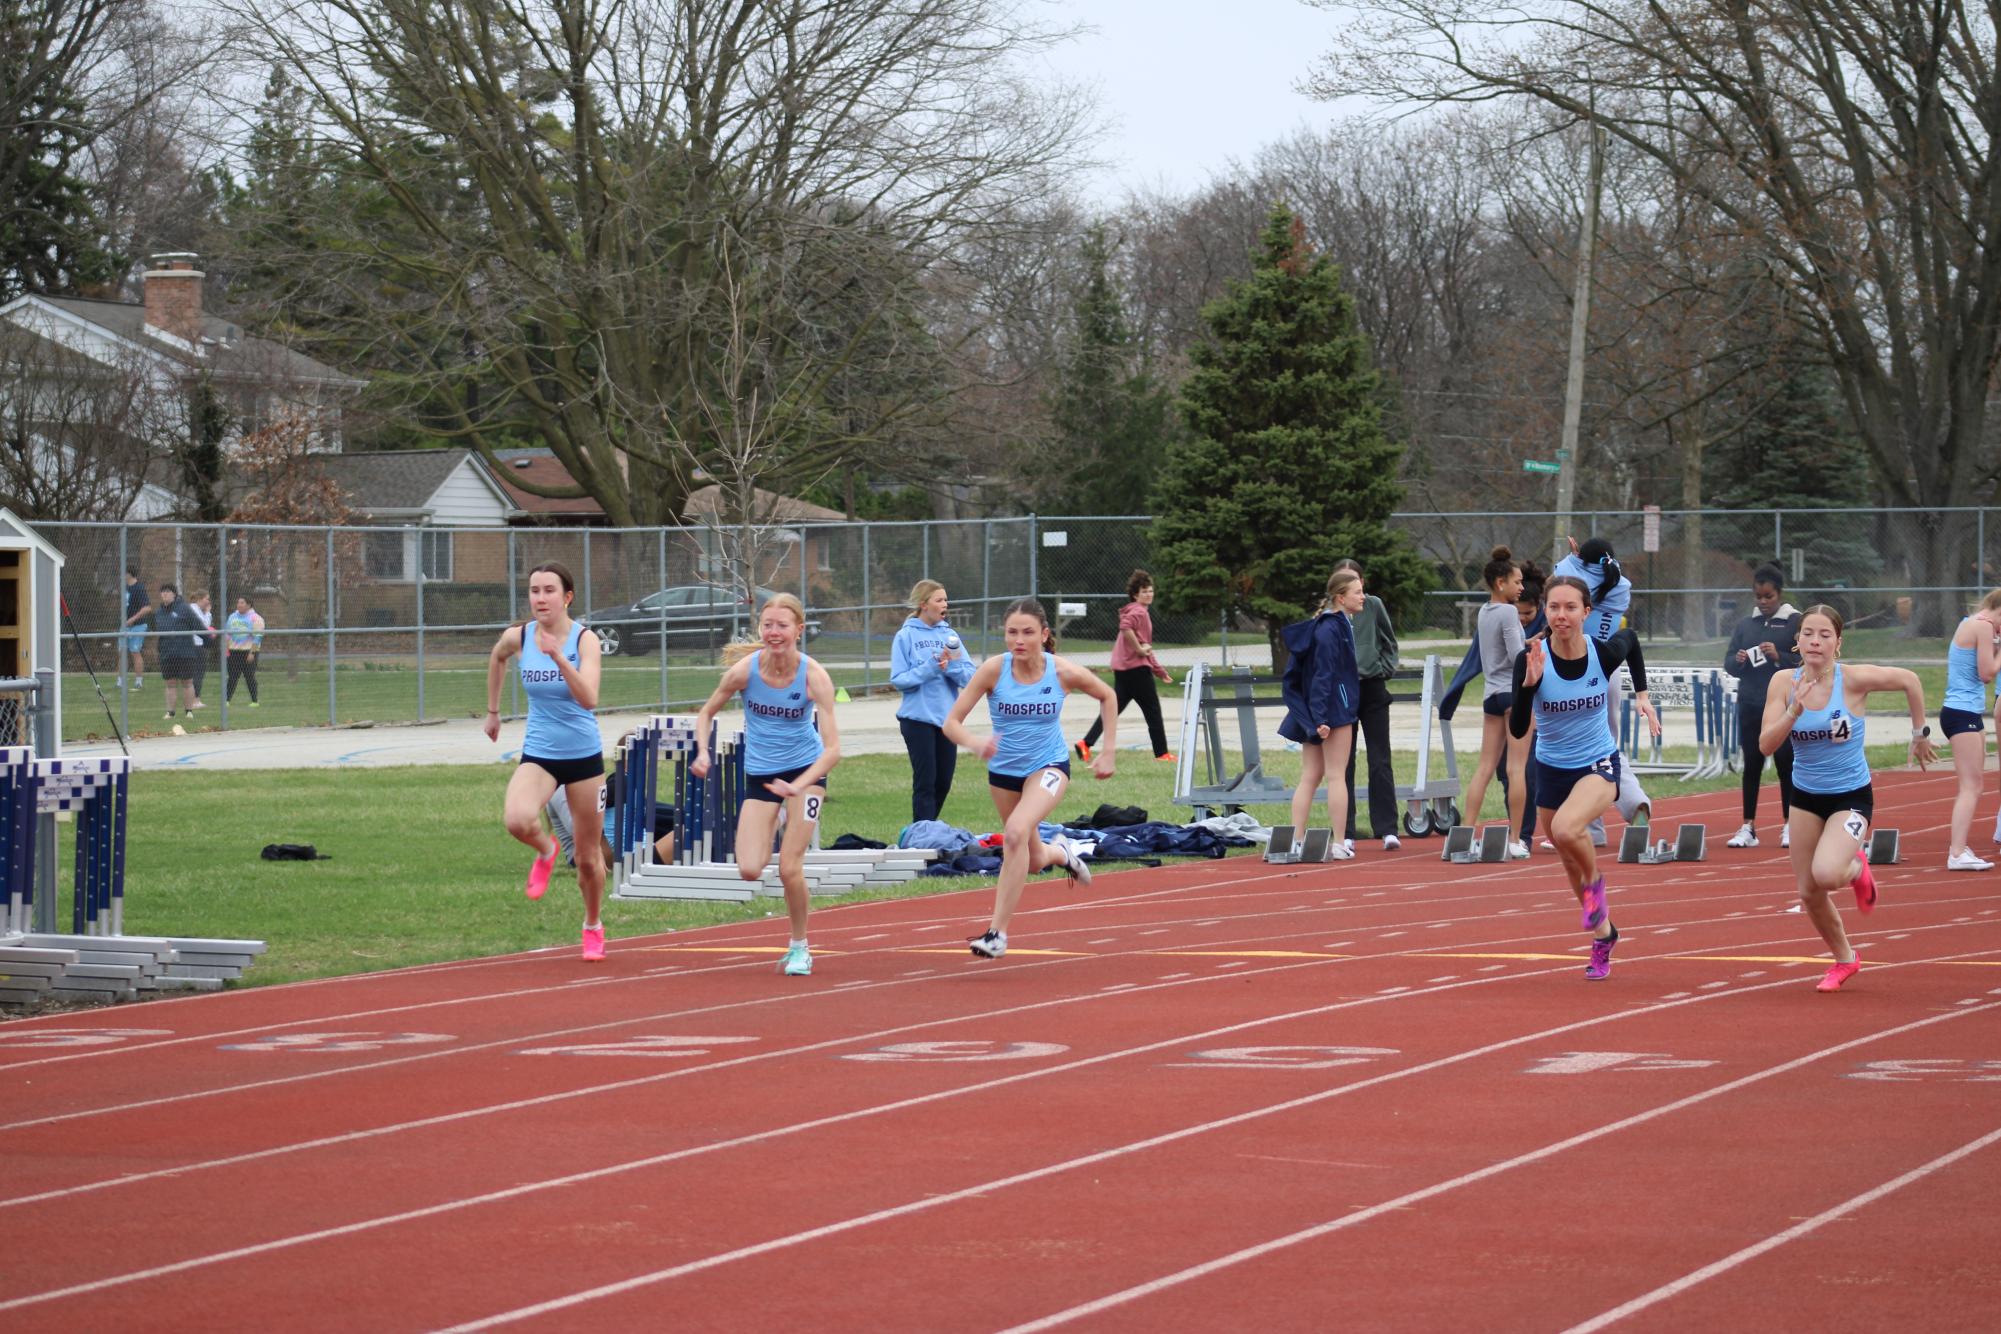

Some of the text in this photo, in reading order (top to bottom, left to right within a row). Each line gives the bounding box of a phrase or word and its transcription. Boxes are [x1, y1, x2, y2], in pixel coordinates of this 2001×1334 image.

[748, 699, 805, 719] PROSPECT
[998, 702, 1057, 715] PROSPECT
[1543, 692, 1605, 712] PROSPECT
[1791, 729, 1833, 741] ROSPE
[1835, 720, 1850, 740] 4
[1046, 771, 1060, 788] 7
[600, 788, 607, 809] 9
[807, 797, 819, 819] 8
[1846, 821, 1863, 837] 4
